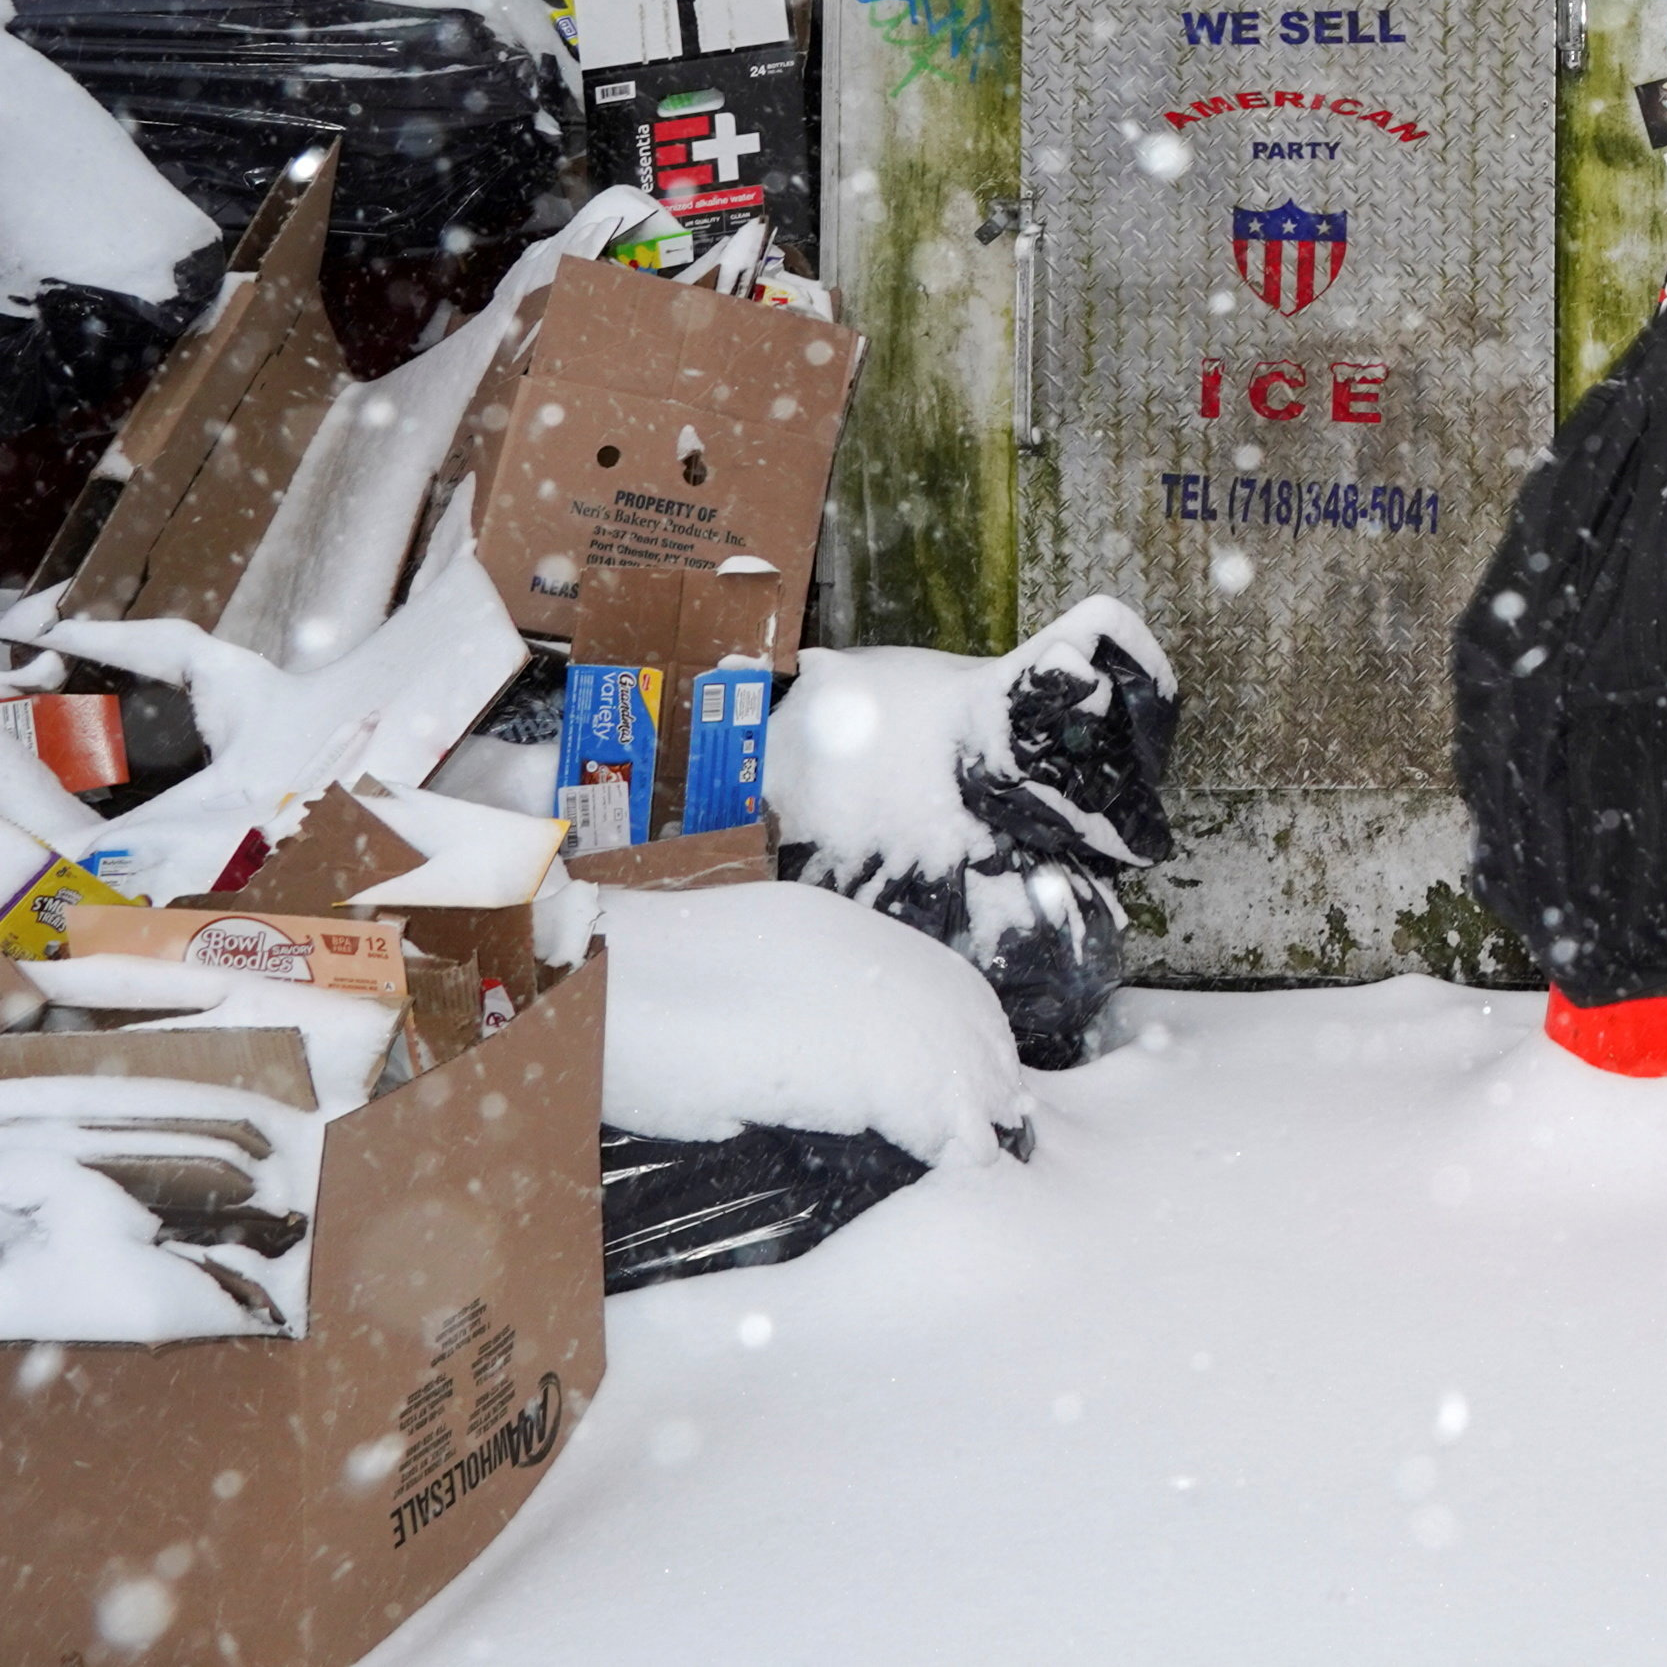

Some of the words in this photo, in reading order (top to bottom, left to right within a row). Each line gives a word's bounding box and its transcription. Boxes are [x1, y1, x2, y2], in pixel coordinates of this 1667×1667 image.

[1181, 11, 1260, 46] WE
[1279, 10, 1406, 46] SELL
[750, 65, 766, 78] 24
[1162, 90, 1429, 144] AMERICAN
[635, 124, 653, 194] essentia
[1252, 140, 1341, 161] PARTY
[728, 191, 756, 202] water
[1199, 357, 1389, 423] ICE
[613, 489, 695, 519] PROPERTY
[697, 508, 719, 523] OF
[1161, 472, 1218, 524] TEL
[1228, 476, 1440, 540] (718)348-5041
[569, 500, 611, 521] Neri's
[613, 509, 660, 532] Bakery
[662, 518, 721, 543] Products,
[724, 533, 747, 547] Inc.
[589, 539, 614, 551] Port
[617, 545, 660, 561] Chester,
[593, 525, 628, 541] 31-37
[660, 537, 695, 552] Street
[530, 575, 580, 600] PLEAS
[593, 672, 618, 742] variety
[200, 929, 267, 955] Bowl
[271, 943, 314, 958] SAVORY
[330, 945, 352, 953] FREE
[331, 935, 352, 945] BPA
[365, 935, 387, 952] 12
[196, 948, 294, 974] Noodles
[389, 1424, 510, 1549] WHOLESALE
